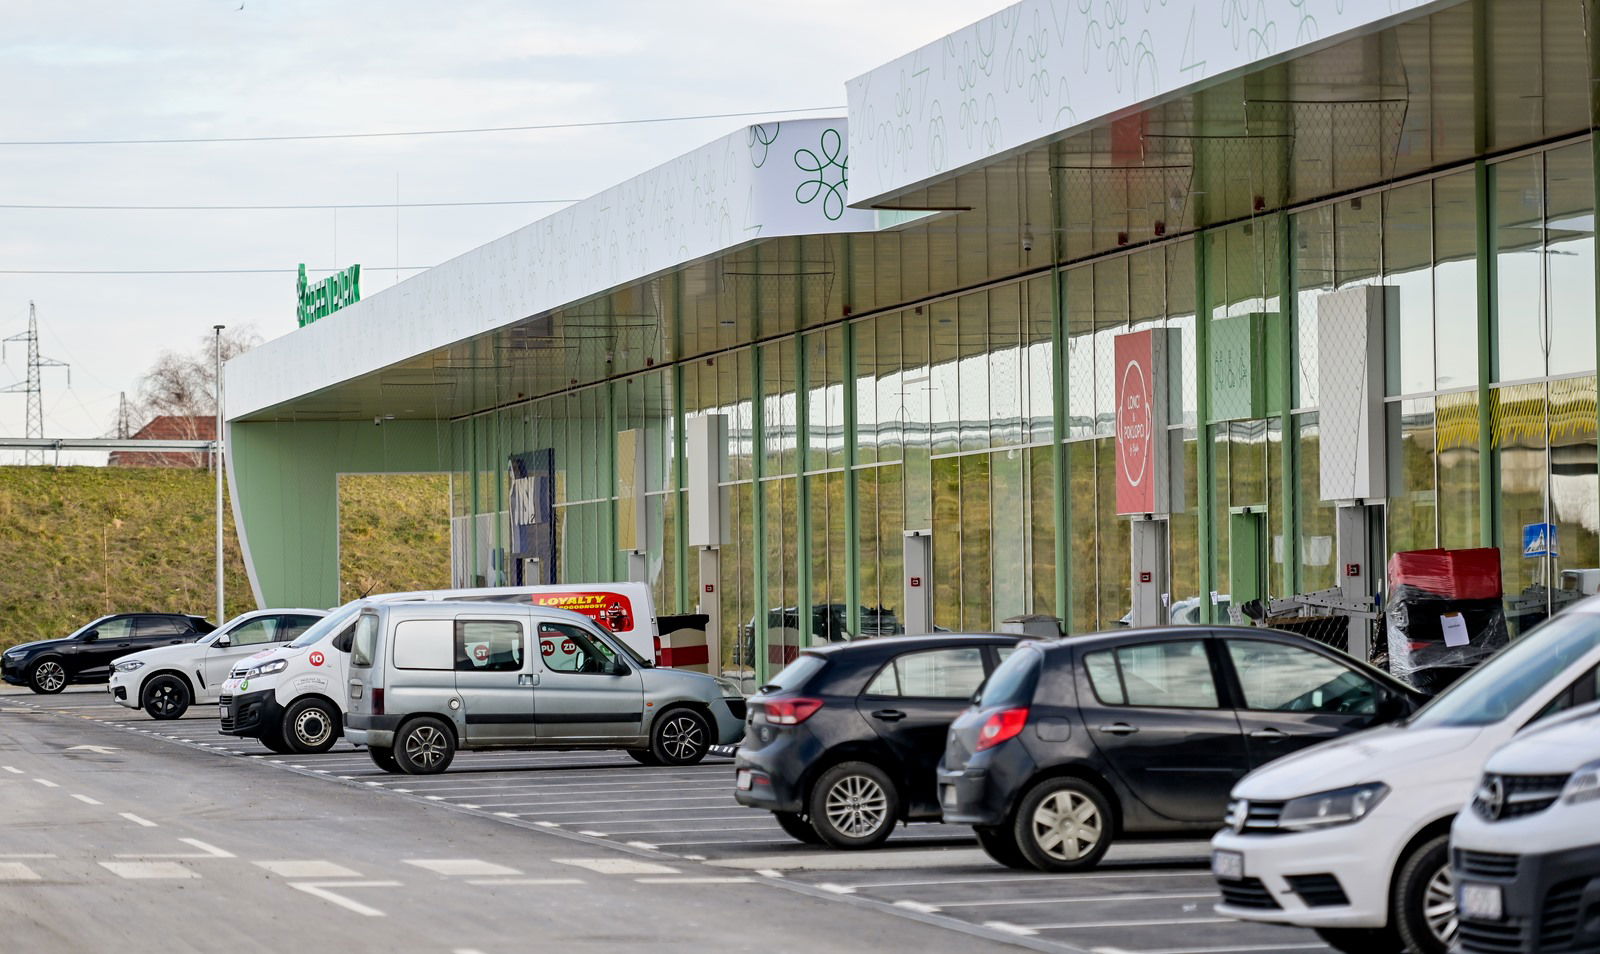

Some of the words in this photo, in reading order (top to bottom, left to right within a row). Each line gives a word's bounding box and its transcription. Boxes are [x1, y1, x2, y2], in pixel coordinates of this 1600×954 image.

[539, 596, 606, 605] LOYALTY
[476, 649, 487, 657] ST
[311, 654, 324, 663] 10
